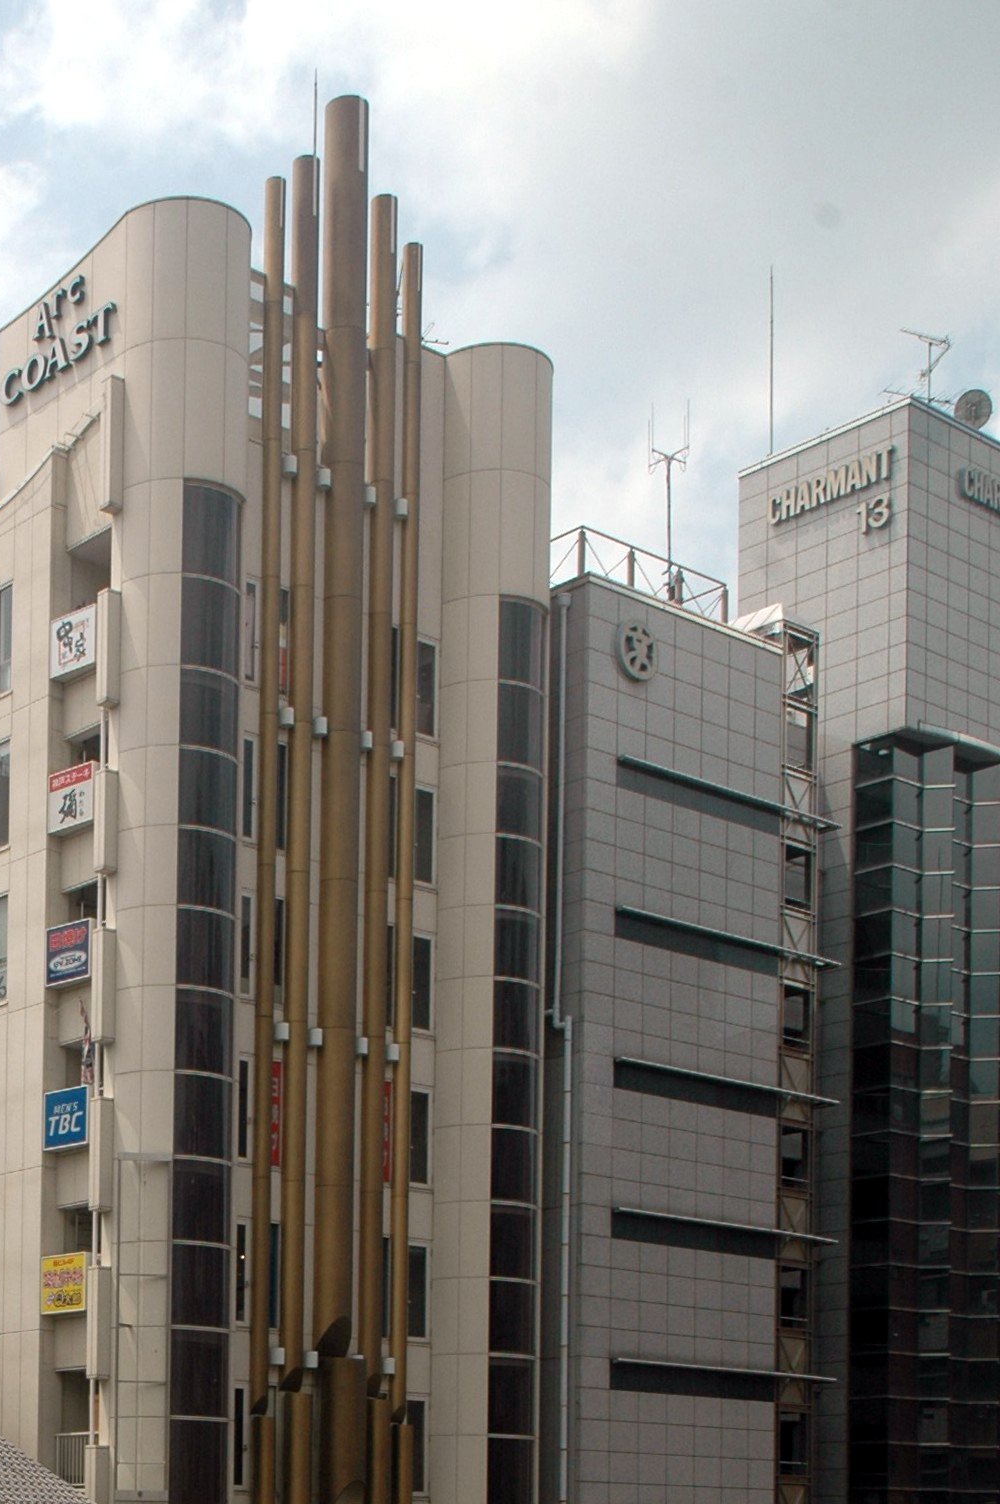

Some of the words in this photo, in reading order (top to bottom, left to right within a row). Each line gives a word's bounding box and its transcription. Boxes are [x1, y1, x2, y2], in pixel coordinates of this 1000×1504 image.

[33, 275, 85, 341] Arc
[1, 302, 117, 407] COAST
[767, 445, 896, 527] CHARMANT
[856, 494, 892, 535] 13
[48, 1111, 84, 1137] TBC
[53, 1101, 79, 1114] MEN'S
